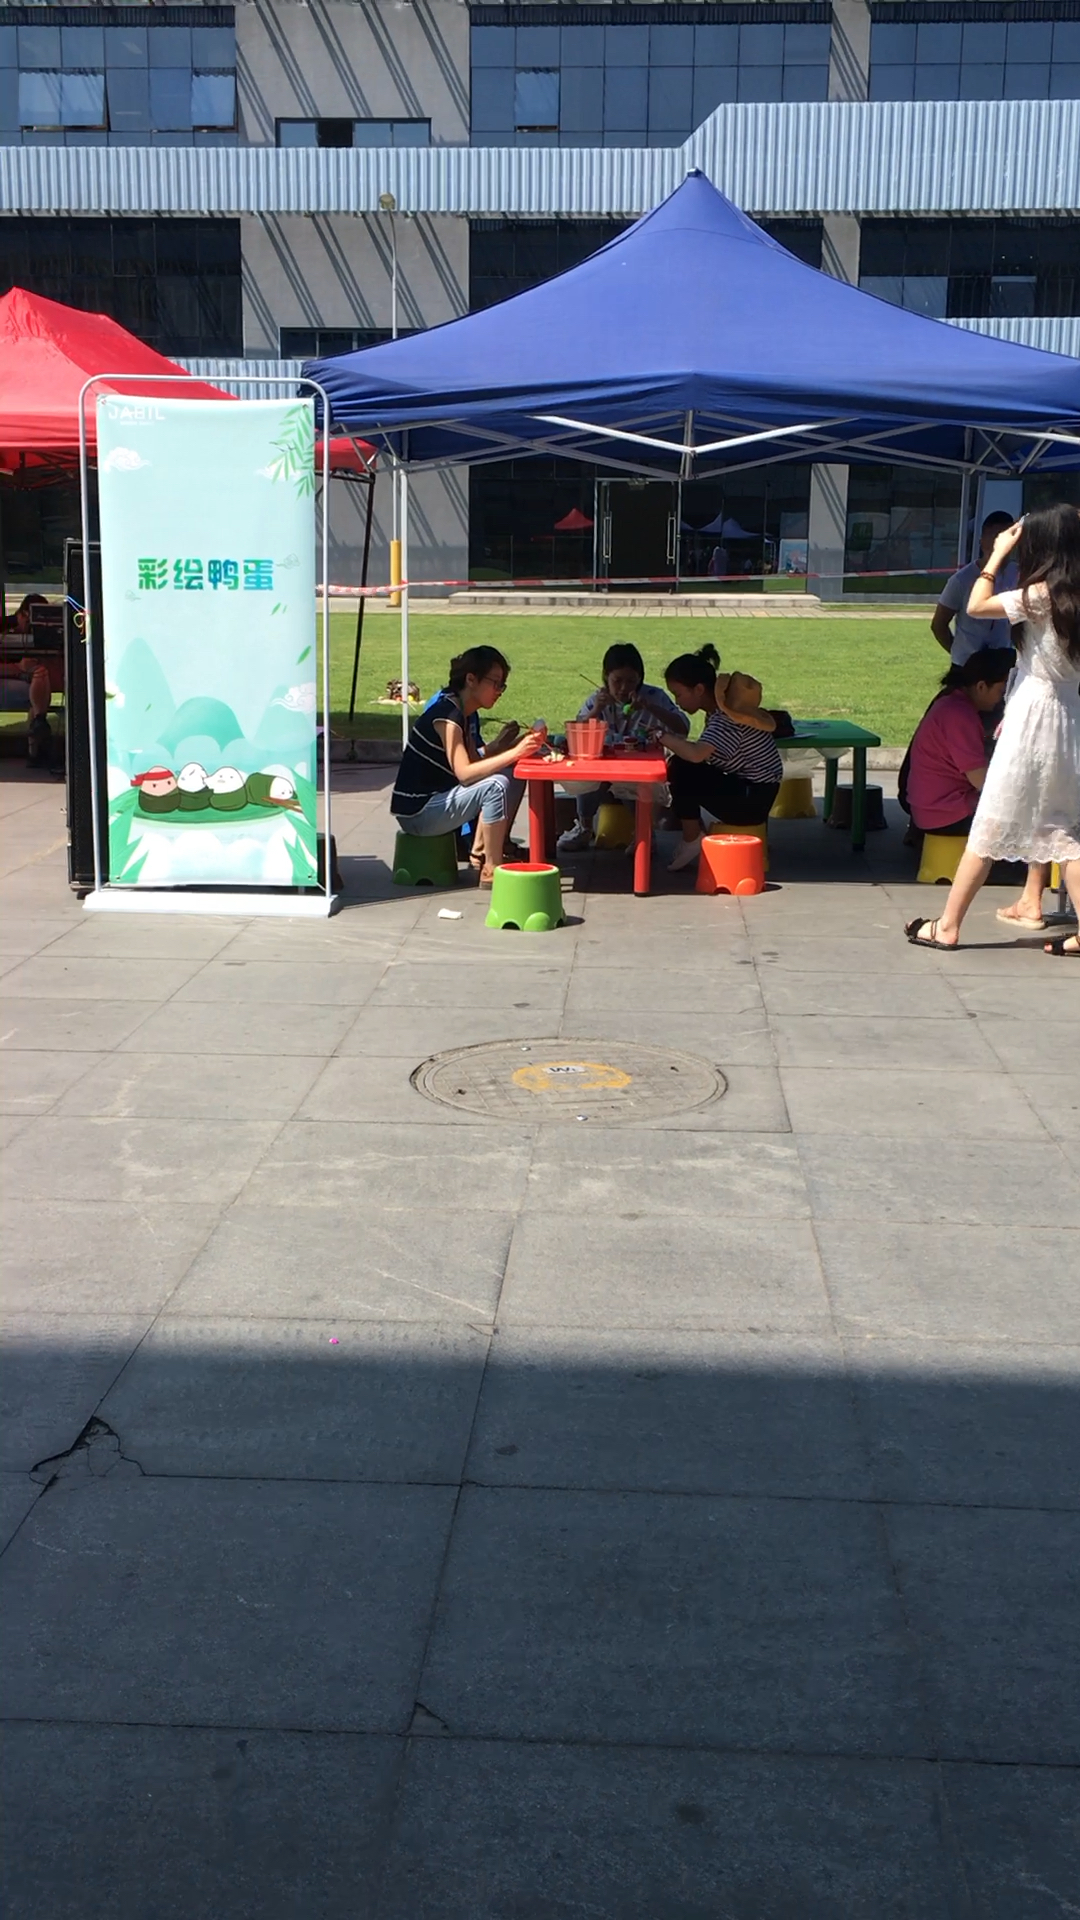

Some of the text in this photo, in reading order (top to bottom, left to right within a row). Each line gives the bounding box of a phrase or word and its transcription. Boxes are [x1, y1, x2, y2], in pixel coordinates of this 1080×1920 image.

[108, 406, 166, 420] JABIL
[138, 558, 274, 590] 彩绘鸭蛋
